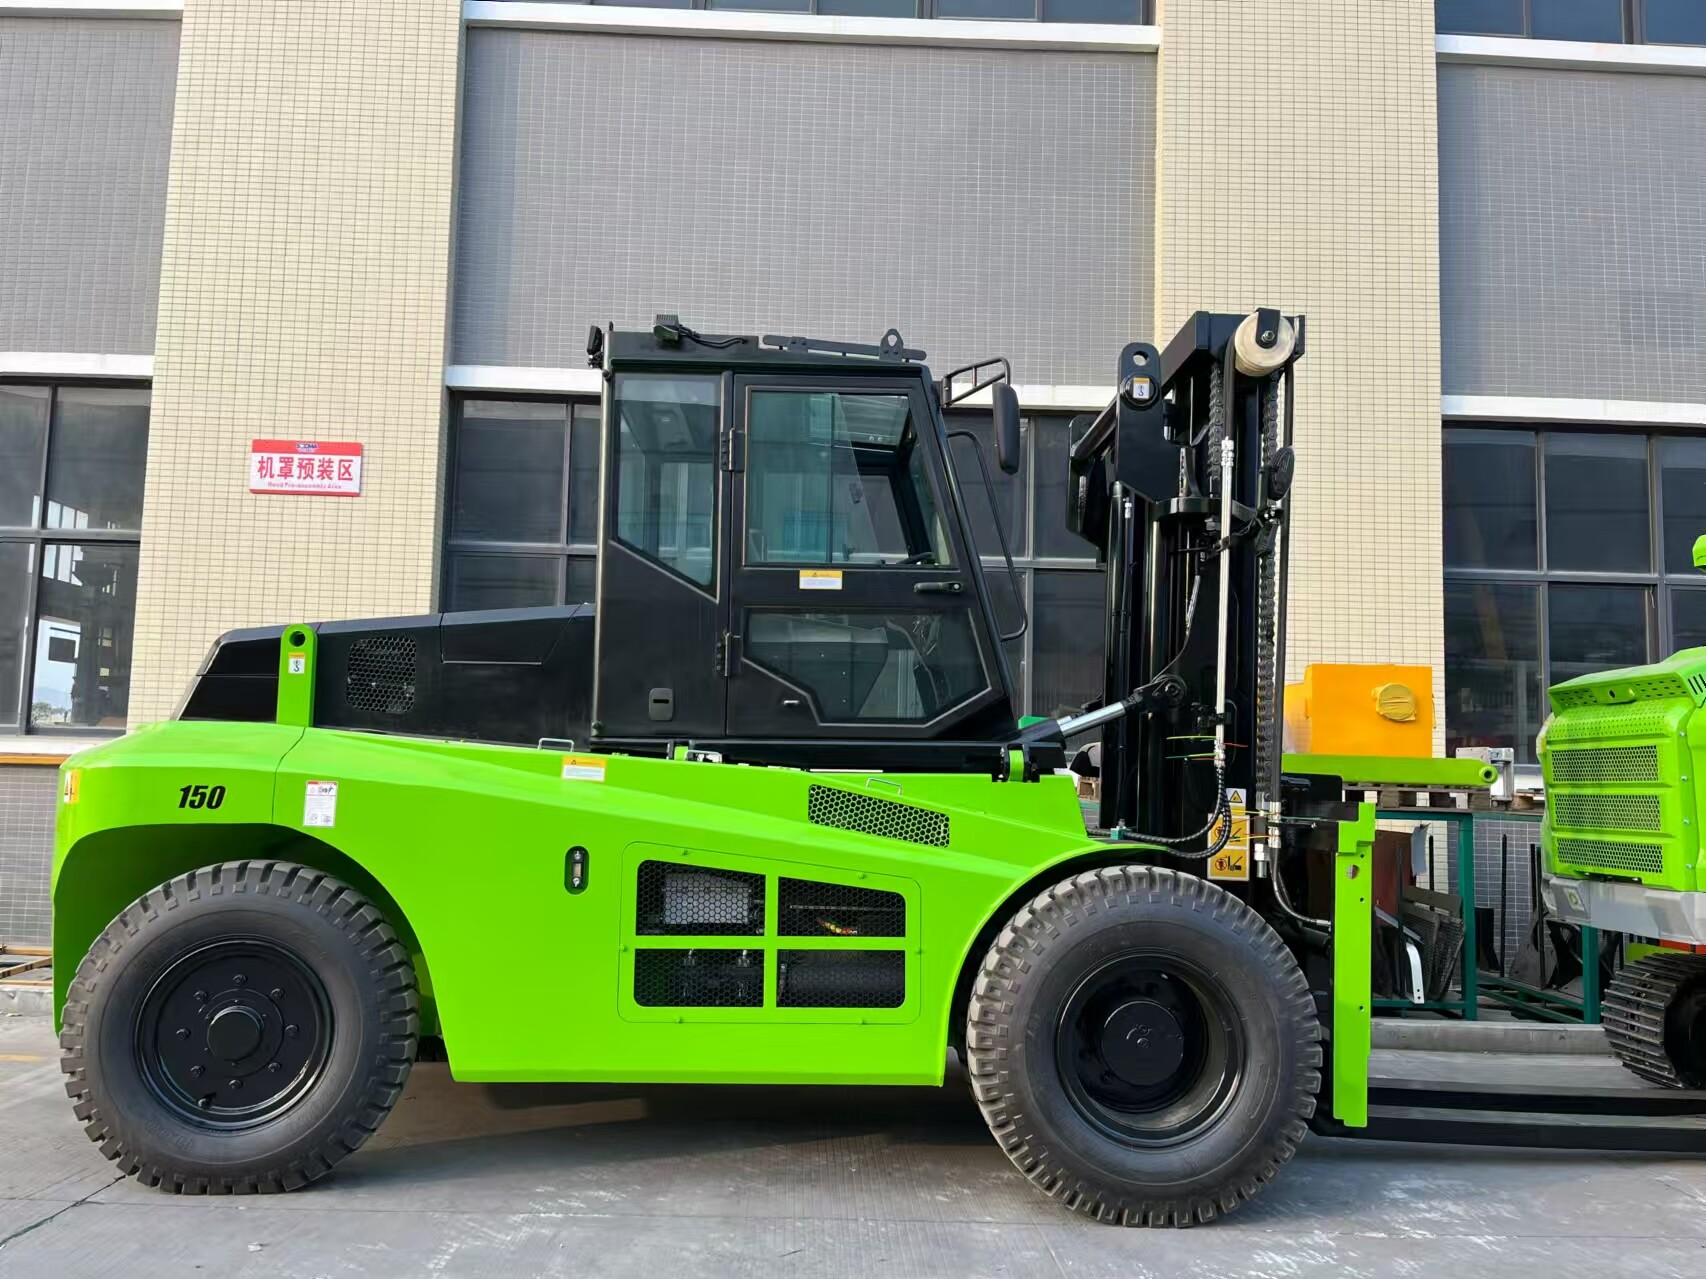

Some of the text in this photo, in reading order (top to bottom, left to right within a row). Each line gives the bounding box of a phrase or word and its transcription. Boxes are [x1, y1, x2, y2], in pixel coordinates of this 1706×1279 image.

[257, 456, 353, 480] 机罩预装区
[179, 785, 226, 809] 150
